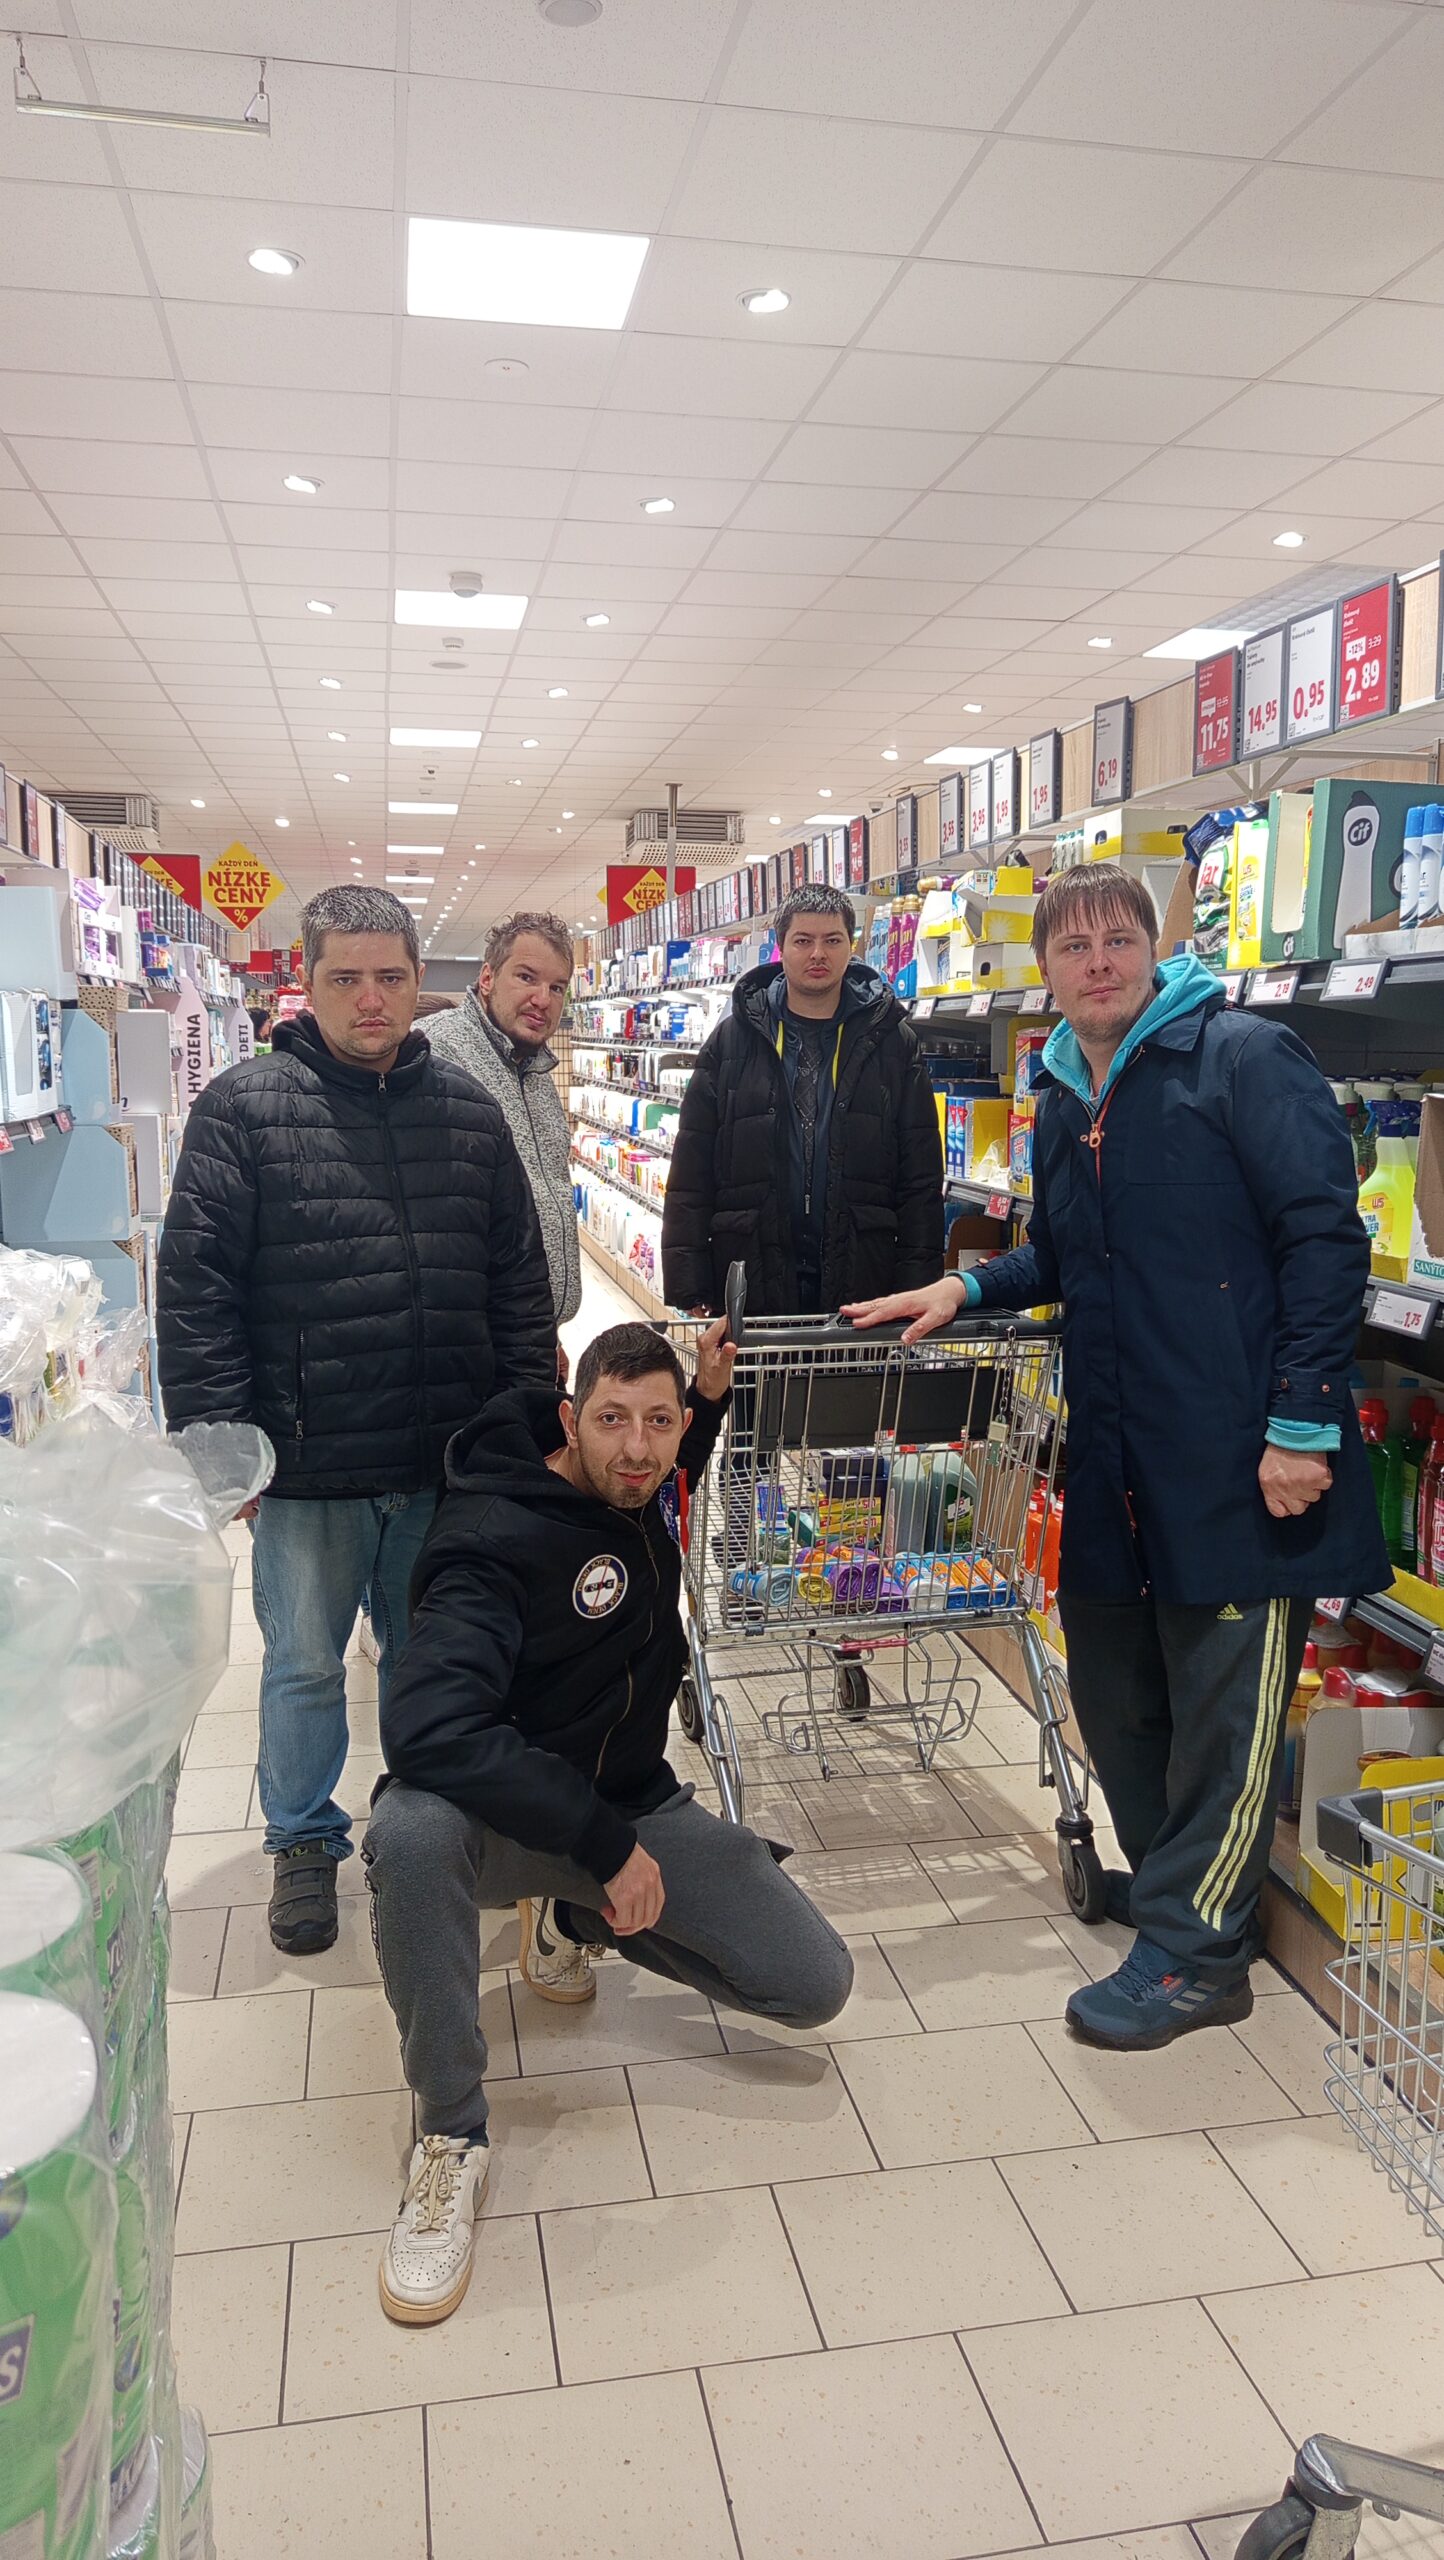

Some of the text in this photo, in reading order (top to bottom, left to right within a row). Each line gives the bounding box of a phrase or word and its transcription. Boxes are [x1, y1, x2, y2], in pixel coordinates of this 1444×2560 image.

[1344, 659, 1380, 703] 2.89
[1293, 679, 1325, 720] 0.95
[1248, 699, 1277, 734] 14.95
[1201, 716, 1229, 752] 11.75
[1098, 758, 1118, 787] 6.19
[1033, 785, 1048, 811] 1.95
[972, 808, 985, 833] 3.95
[1351, 820, 1371, 843] Cif
[218, 859, 242, 867] KAŽDÝ
[208, 867, 271, 887] NÍZKE
[213, 888, 267, 904] CENY
[632, 887, 665, 900] NÍZK
[1283, 937, 1294, 953] Cif
[1355, 977, 1375, 993] 2.49
[238, 1024, 249, 1053] DETI
[187, 1013, 202, 1096] HYGIENA
[1404, 1311, 1422, 1328] 1.75
